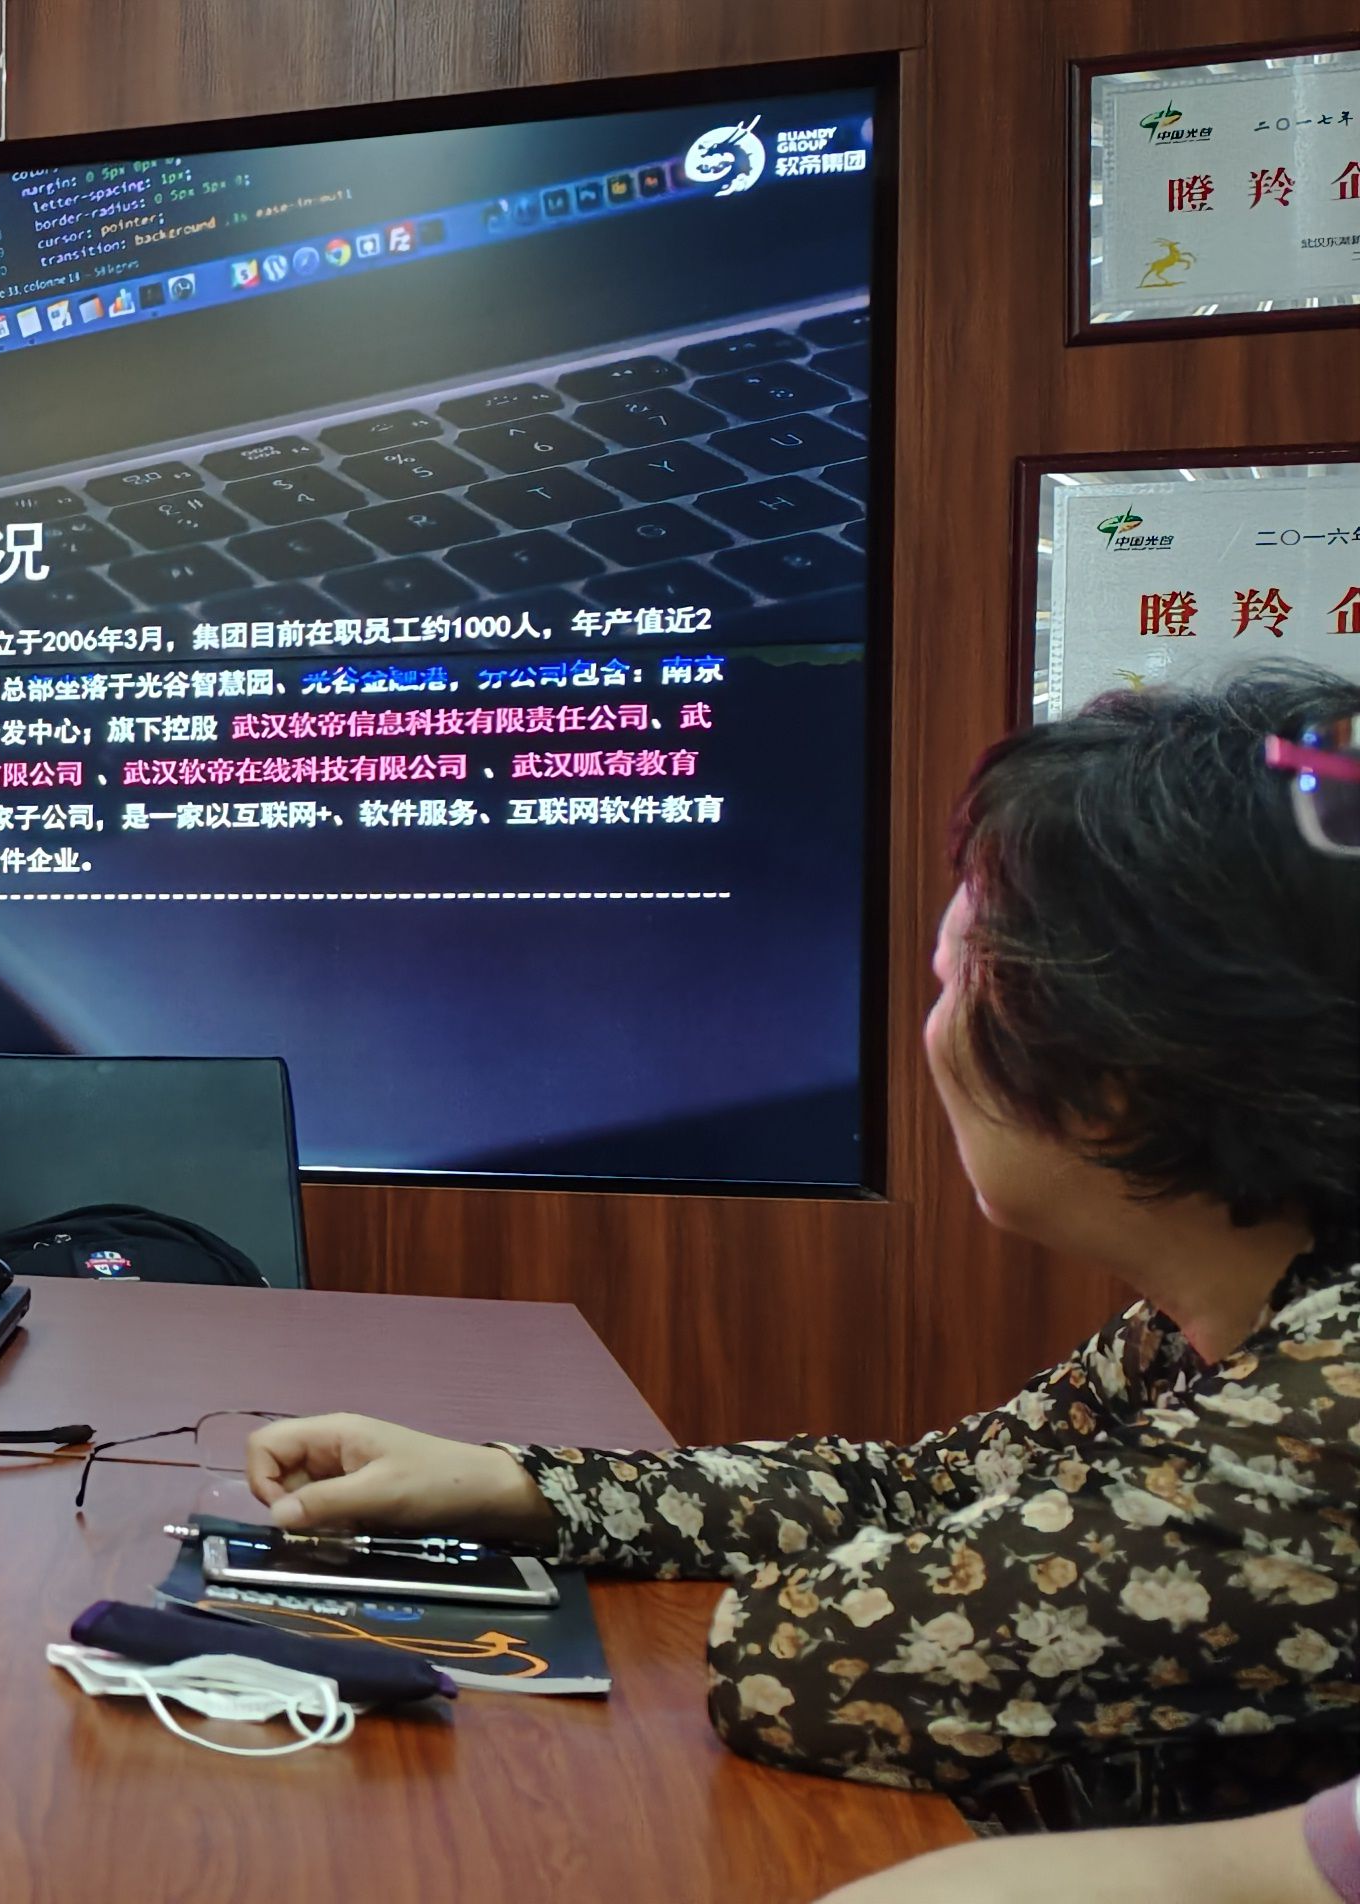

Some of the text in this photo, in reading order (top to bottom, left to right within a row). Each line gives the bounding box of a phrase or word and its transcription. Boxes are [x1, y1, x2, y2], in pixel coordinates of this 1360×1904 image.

[776, 139, 828, 154] GROUP
[774, 149, 867, 177] 软帝集团
[34, 198, 146, 232] border-radius:
[37, 228, 92, 249] cursor:
[40, 239, 127, 268] transition:
[134, 215, 217, 246] background
